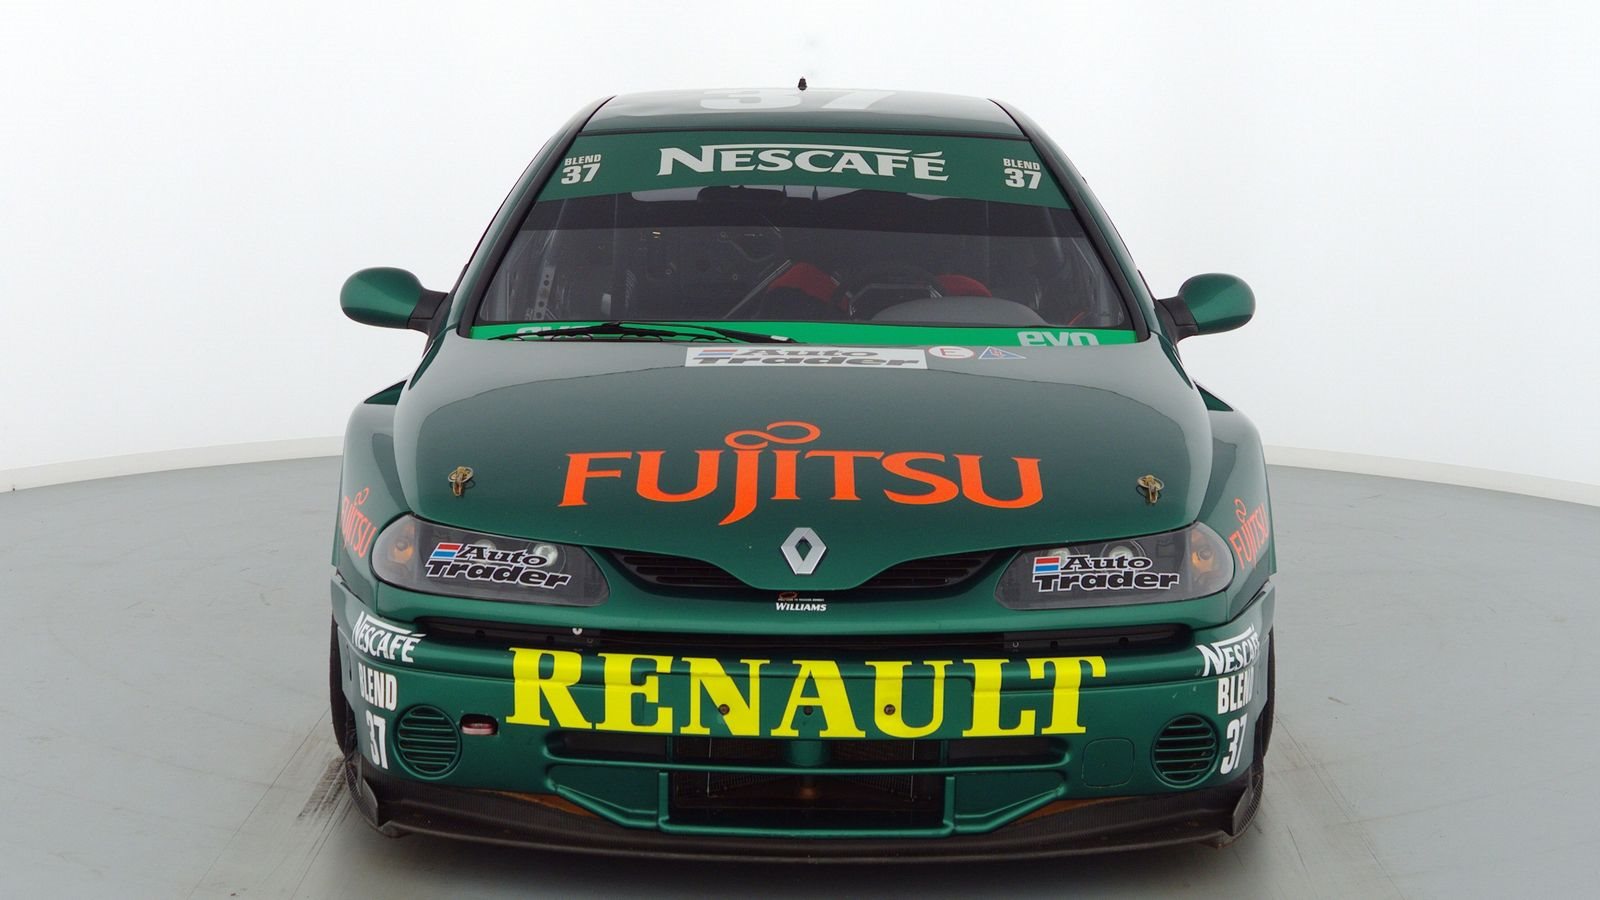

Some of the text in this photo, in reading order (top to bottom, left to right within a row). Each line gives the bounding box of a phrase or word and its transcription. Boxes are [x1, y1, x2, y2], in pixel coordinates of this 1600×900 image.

[700, 89, 897, 110] 37
[564, 153, 602, 166] BLEND
[656, 143, 950, 181] NESCAFÉ
[1003, 158, 1041, 171] BLEND
[561, 162, 601, 185] 37
[1004, 168, 1042, 189] 37
[692, 356, 921, 367] Trader
[735, 348, 880, 357] Auto
[557, 446, 1044, 525] FUJITSU
[456, 544, 549, 567] Auto
[1059, 554, 1153, 571] Auto
[425, 560, 572, 590] Trader
[1032, 571, 1180, 592] Trader
[775, 602, 827, 612] WILLIAMS
[352, 611, 427, 663] NESCAFÉ
[505, 647, 1106, 738] RENAULT
[365, 709, 389, 770] 37
[1220, 713, 1248, 775] 37
